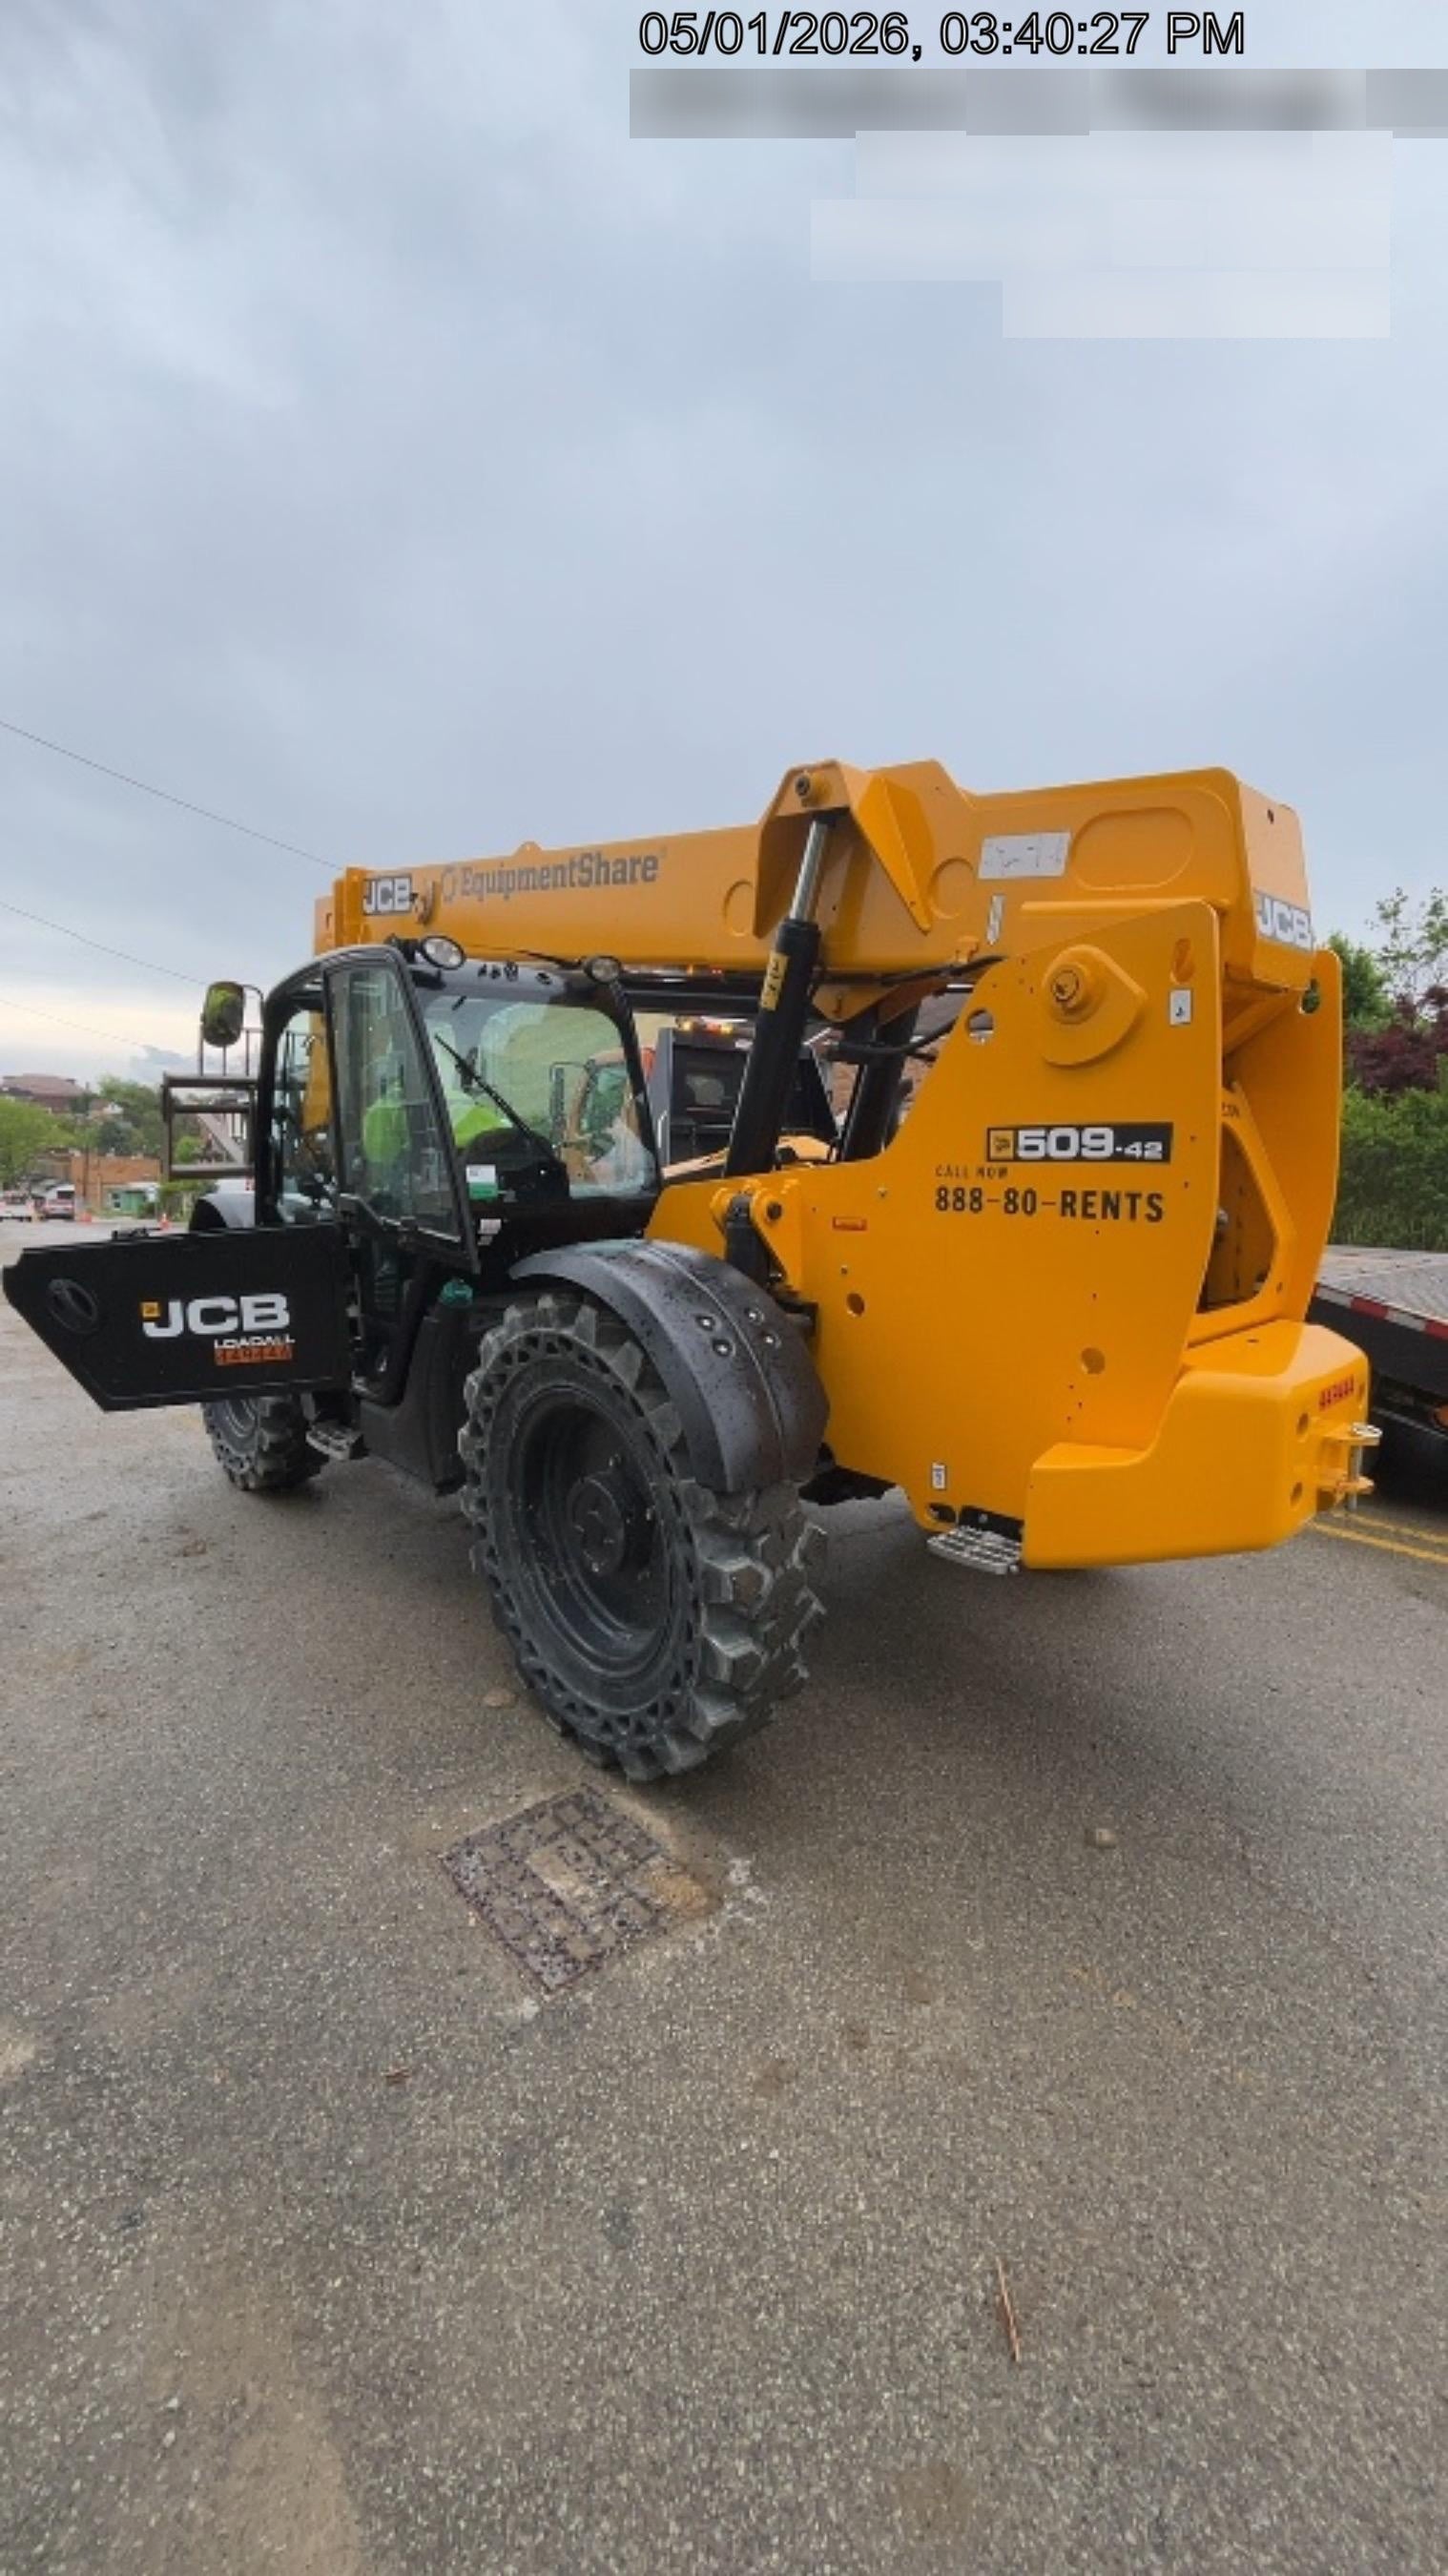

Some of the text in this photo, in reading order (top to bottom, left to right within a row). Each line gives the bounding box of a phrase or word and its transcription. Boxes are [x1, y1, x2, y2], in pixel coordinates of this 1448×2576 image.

[363, 875, 411, 916] JCB
[461, 853, 658, 902] EquipmentShare
[1255, 893, 1313, 950] JCB
[1017, 1127, 1163, 1160] 509-42
[935, 1185, 1164, 1222] 888-80-RENTS
[141, 1293, 290, 1338] JCB
